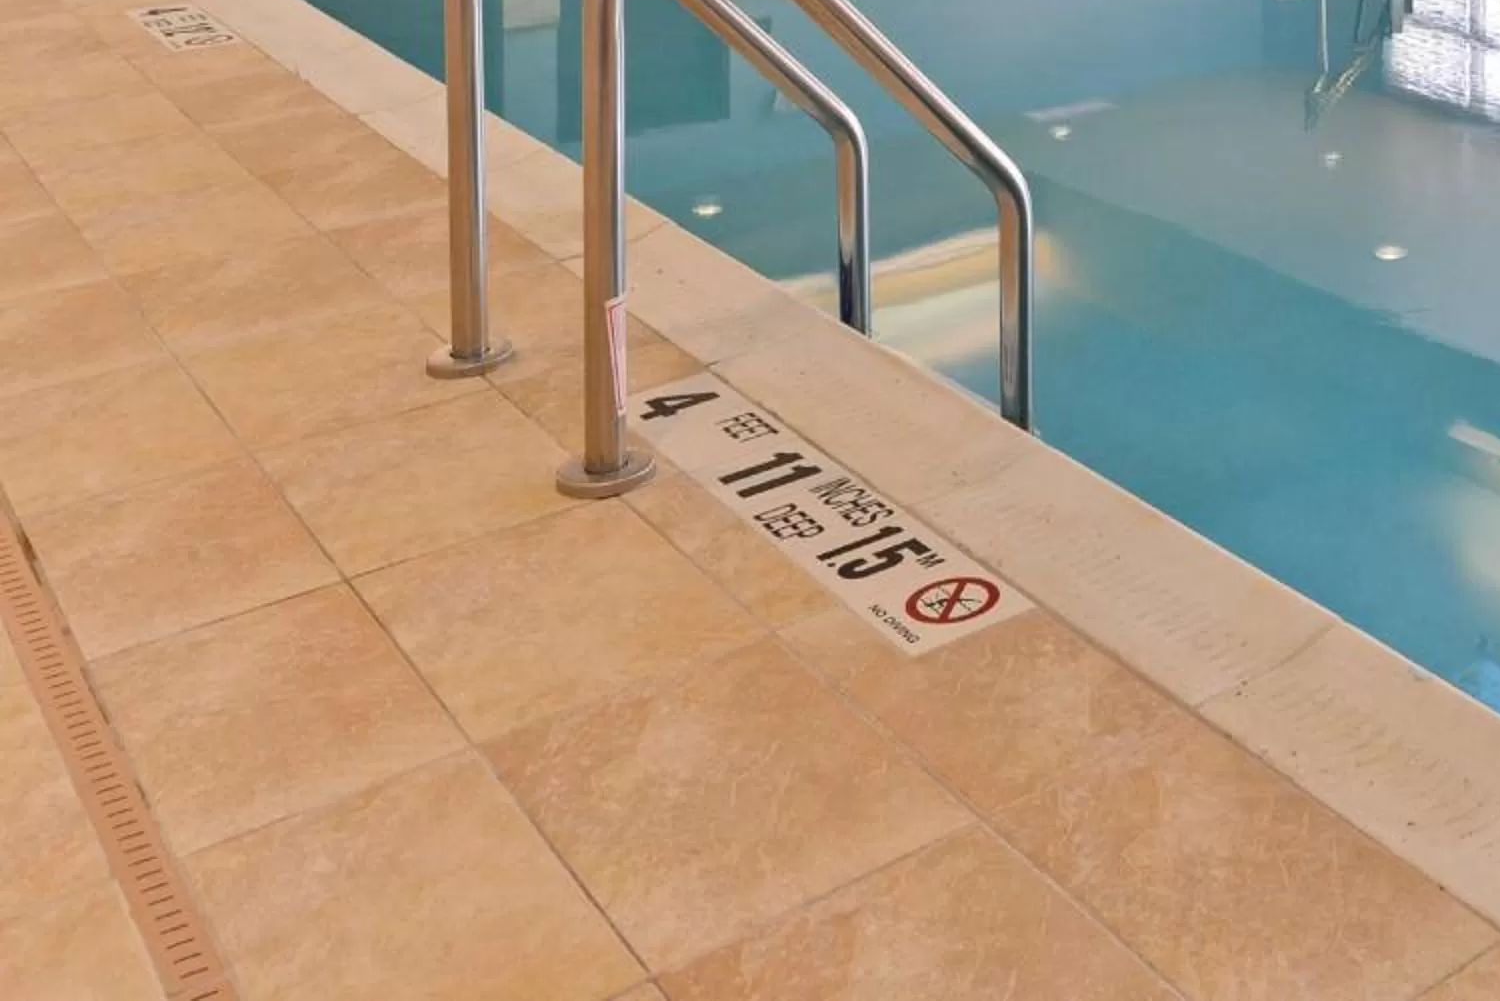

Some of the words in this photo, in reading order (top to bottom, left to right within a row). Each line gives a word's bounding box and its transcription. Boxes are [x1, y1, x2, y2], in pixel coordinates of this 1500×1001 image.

[638, 391, 720, 421] 4
[718, 412, 779, 443] FEET
[718, 451, 823, 499] 11
[808, 476, 894, 528] INCHES
[753, 502, 825, 540] DEEP
[867, 604, 887, 618] NO
